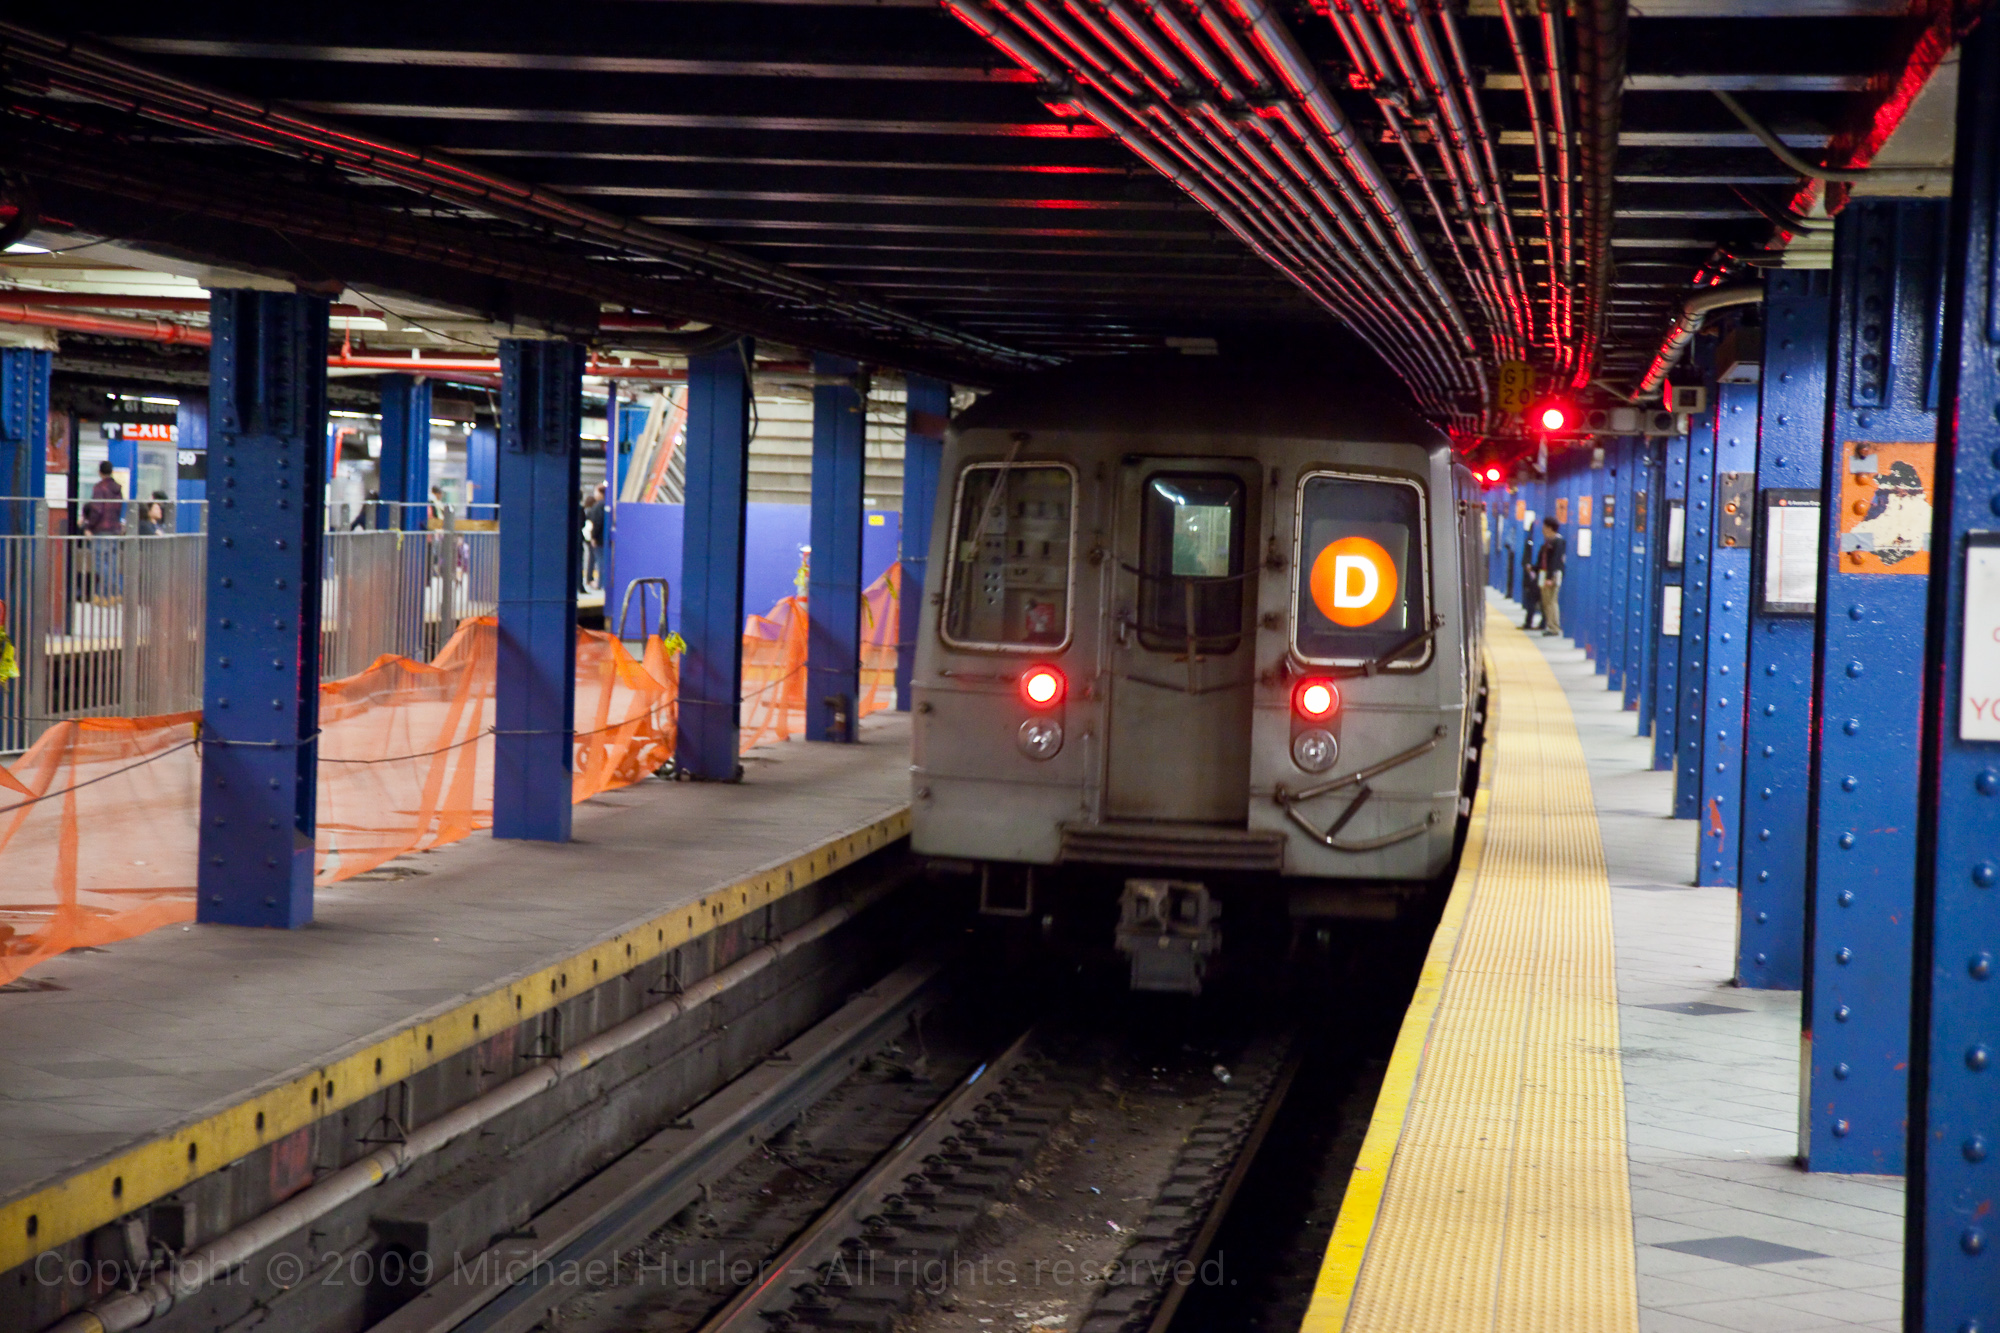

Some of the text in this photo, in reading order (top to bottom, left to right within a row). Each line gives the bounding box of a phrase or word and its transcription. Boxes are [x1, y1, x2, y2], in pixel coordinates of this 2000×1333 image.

[1504, 368, 1530, 385] GT
[1503, 388, 1531, 405] 20
[1334, 555, 1378, 608] D
